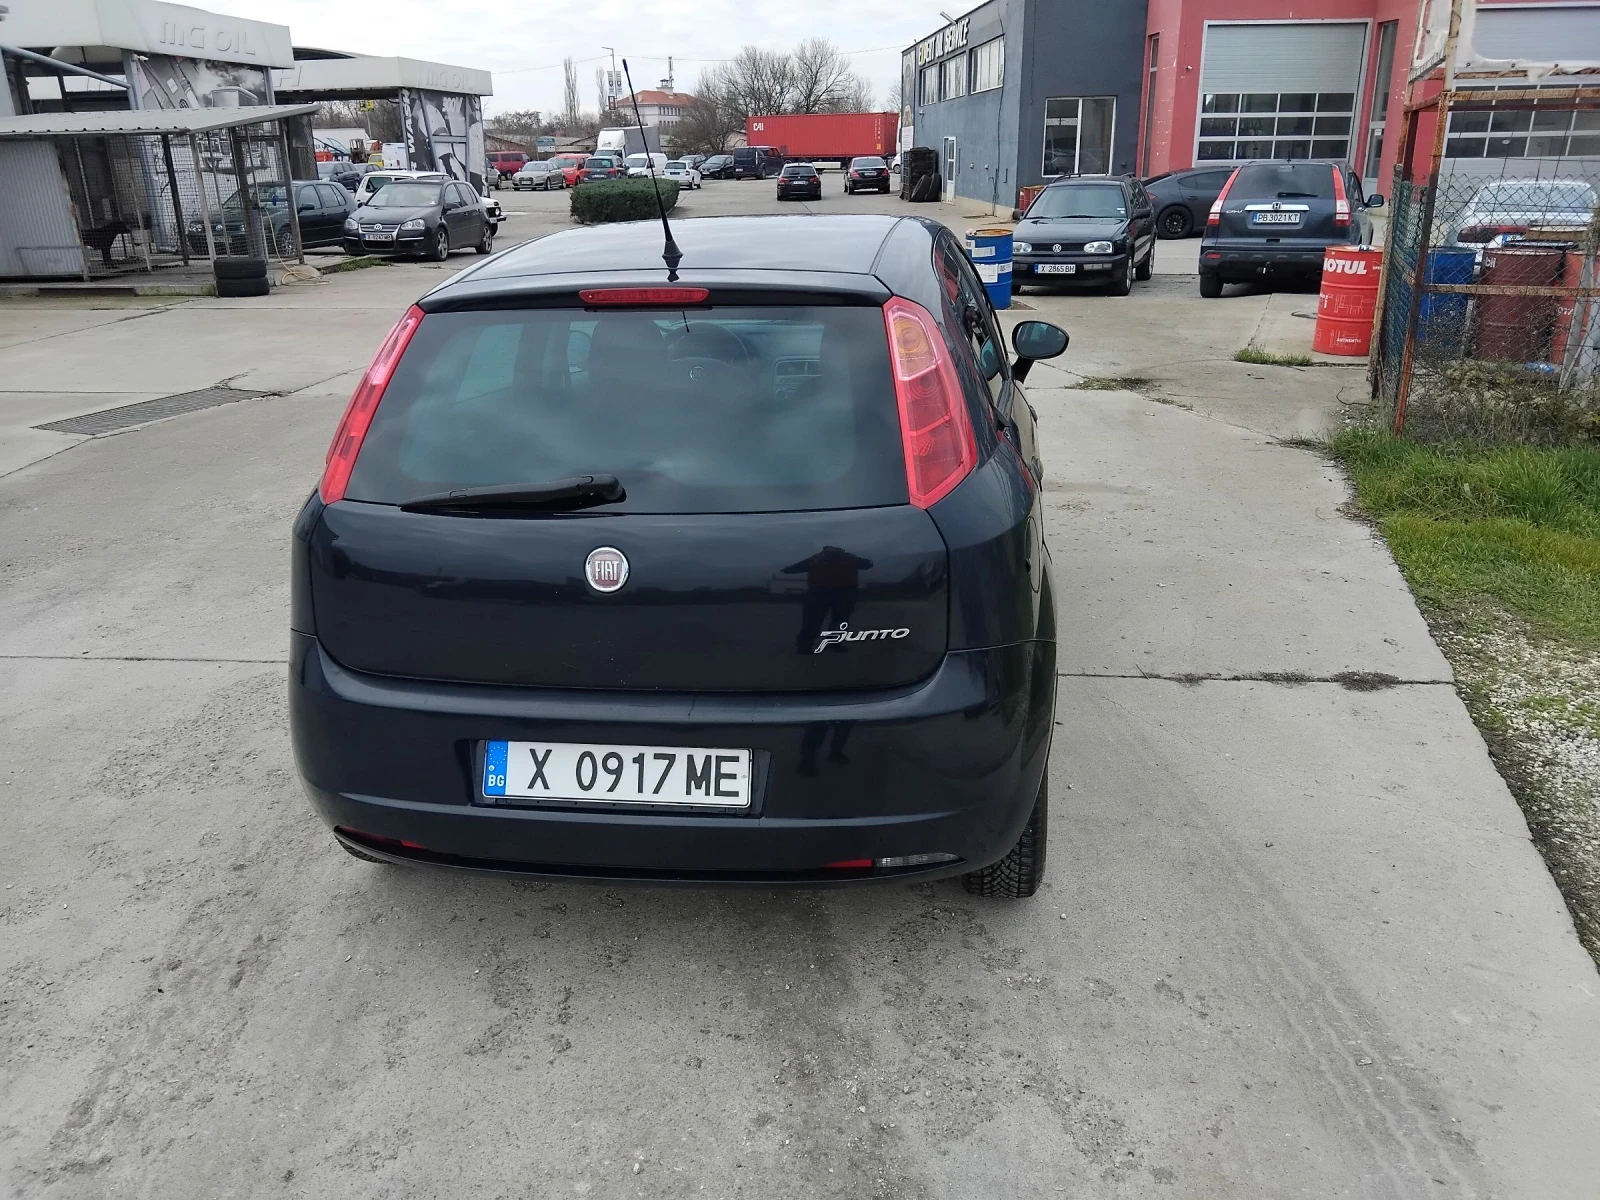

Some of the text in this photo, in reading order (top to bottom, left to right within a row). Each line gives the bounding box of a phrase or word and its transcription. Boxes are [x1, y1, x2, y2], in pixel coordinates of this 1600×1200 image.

[216, 31, 256, 56] OIL
[452, 73, 473, 91] OIL
[753, 122, 764, 132] CAI
[1269, 213, 1287, 222] 3021
[1048, 265, 1065, 273] 2865
[595, 560, 619, 581] FIAT
[487, 774, 505, 787] BG
[527, 748, 740, 798] X 0917 ME
